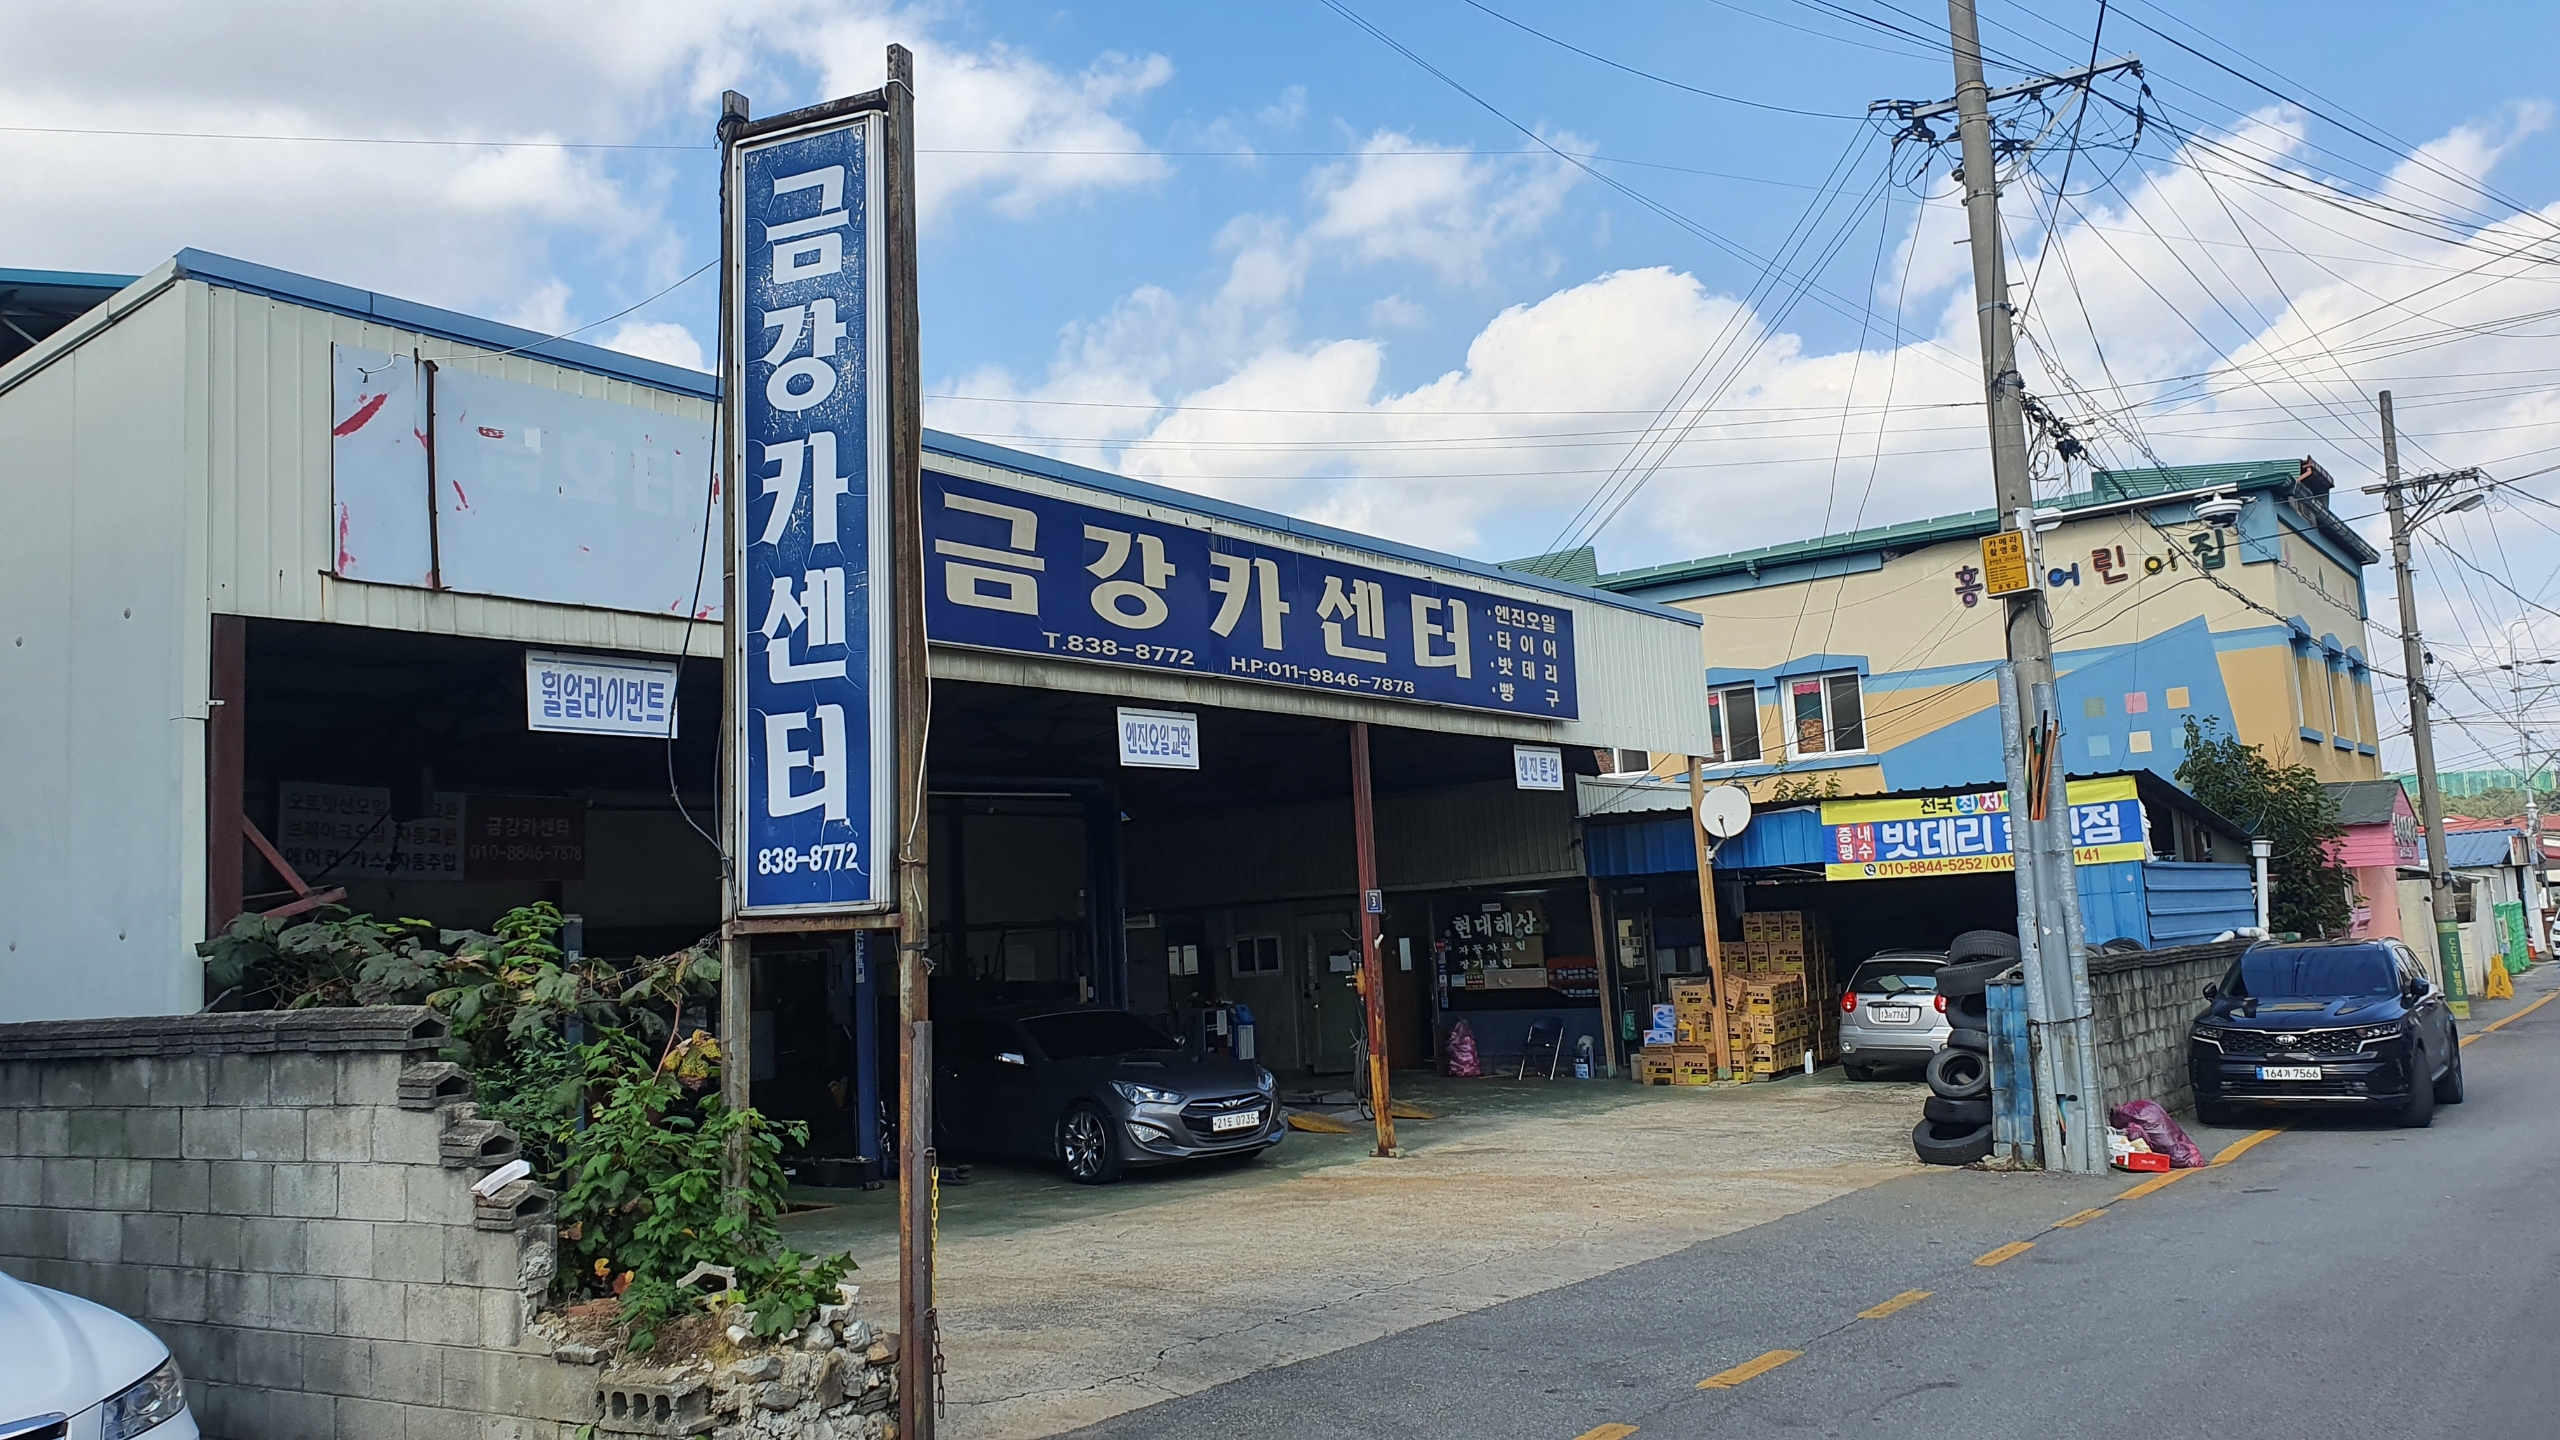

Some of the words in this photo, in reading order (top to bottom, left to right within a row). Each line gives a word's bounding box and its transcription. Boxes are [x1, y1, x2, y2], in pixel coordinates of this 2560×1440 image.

[763, 164, 849, 826] 금강카센터
[935, 492, 1472, 679] 금강카센터
[1494, 604, 1556, 634] 엔진오일
[1042, 630, 1196, 666] T.838-8772
[1497, 630, 1557, 660] 타이어
[1498, 656, 1558, 684] 밧데리
[541, 671, 664, 722] 휠얼라이먼트
[1126, 722, 1191, 758] 엔진오일교환
[1519, 755, 1558, 783] 엔진튠업
[485, 816, 570, 839] 금강카센터
[1881, 815, 1993, 860] 밧데리
[758, 842, 858, 875] 838-8772
[1453, 910, 1537, 939] 현대해상
[1458, 940, 1526, 956] 자동차보험
[1459, 958, 1512, 970] 장기보험
[2278, 1035, 2297, 1044] KIA
[2293, 1068, 2319, 1078] 7566
